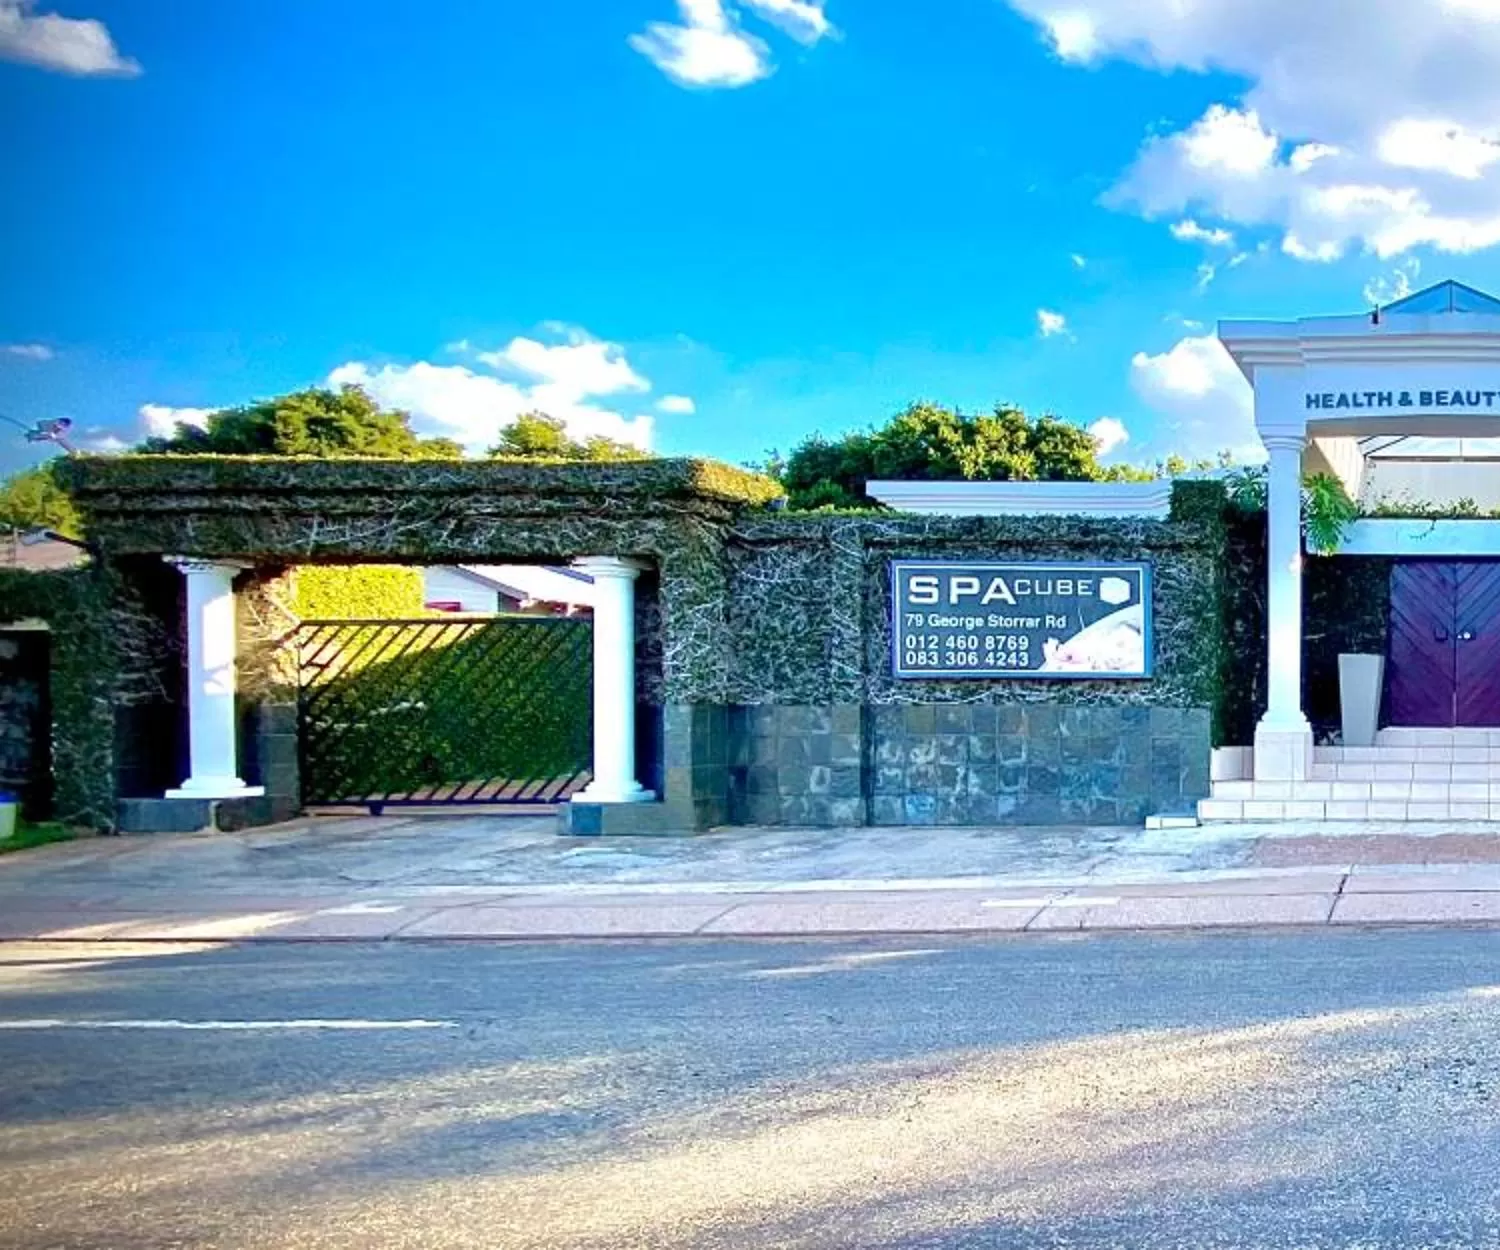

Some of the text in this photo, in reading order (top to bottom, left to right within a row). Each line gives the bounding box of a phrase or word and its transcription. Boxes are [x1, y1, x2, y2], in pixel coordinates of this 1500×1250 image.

[1306, 392, 1392, 409] HEALTH
[1398, 392, 1412, 406] &
[908, 575, 1093, 605] SPA CUBE
[905, 614, 1067, 630] 79 George Storrar Rd
[906, 636, 1029, 650] 012 460 8769
[906, 651, 1029, 666] 083 306 4243
